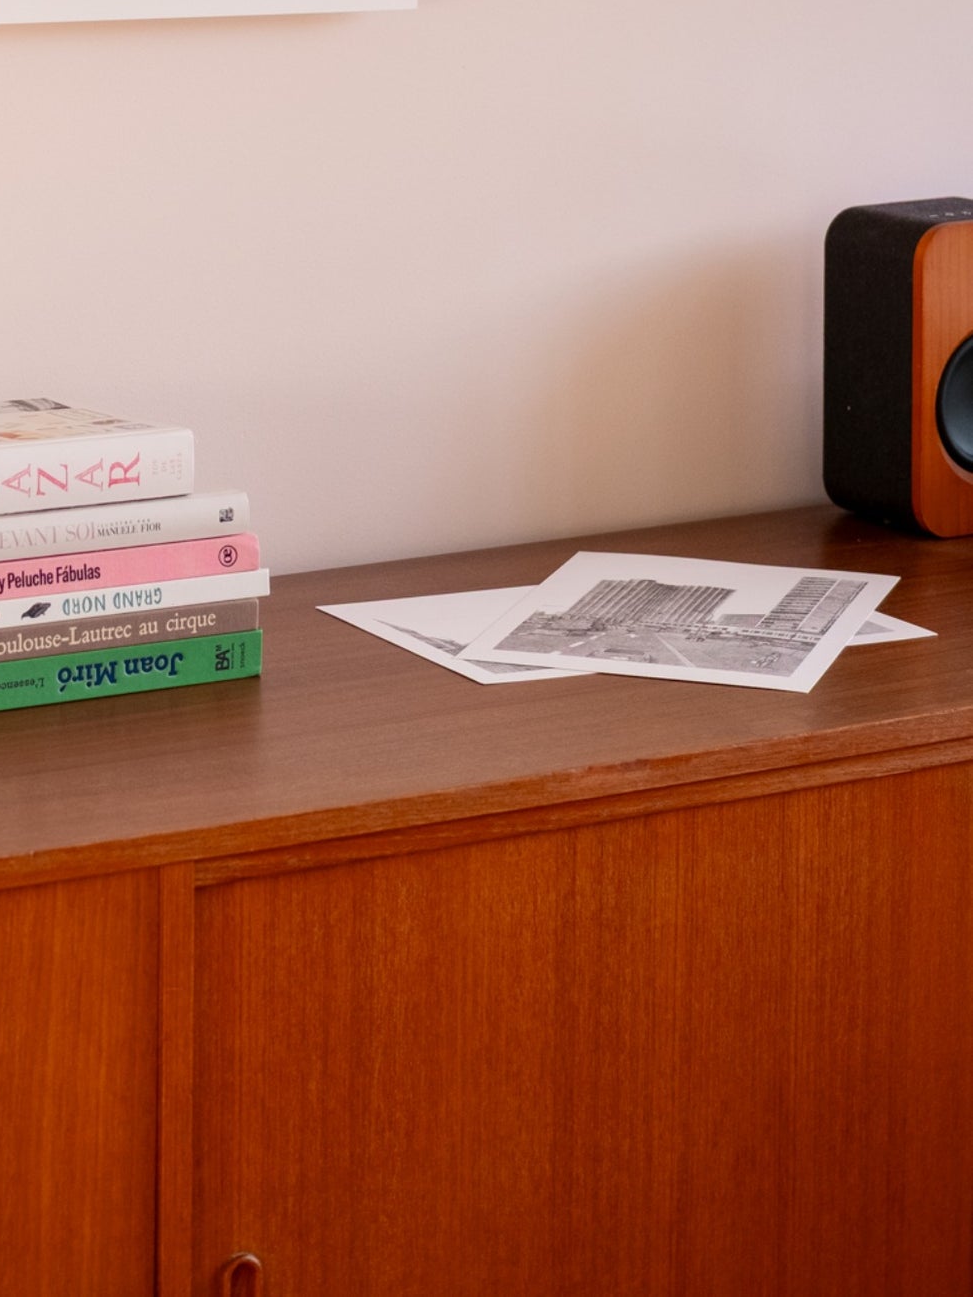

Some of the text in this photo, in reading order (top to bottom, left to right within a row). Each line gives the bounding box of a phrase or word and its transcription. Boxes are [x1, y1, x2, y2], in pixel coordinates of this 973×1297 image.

[66, 520, 95, 543] SOI
[97, 524, 139, 537] MANUELE
[141, 522, 161, 533] FIOR
[8, 568, 53, 589] Peluche
[56, 563, 101, 583] Fábulas
[62, 587, 163, 616] GRAND NORD
[139, 620, 158, 635] au
[166, 612, 216, 633] cirque
[57, 652, 184, 693] Joan Miró
